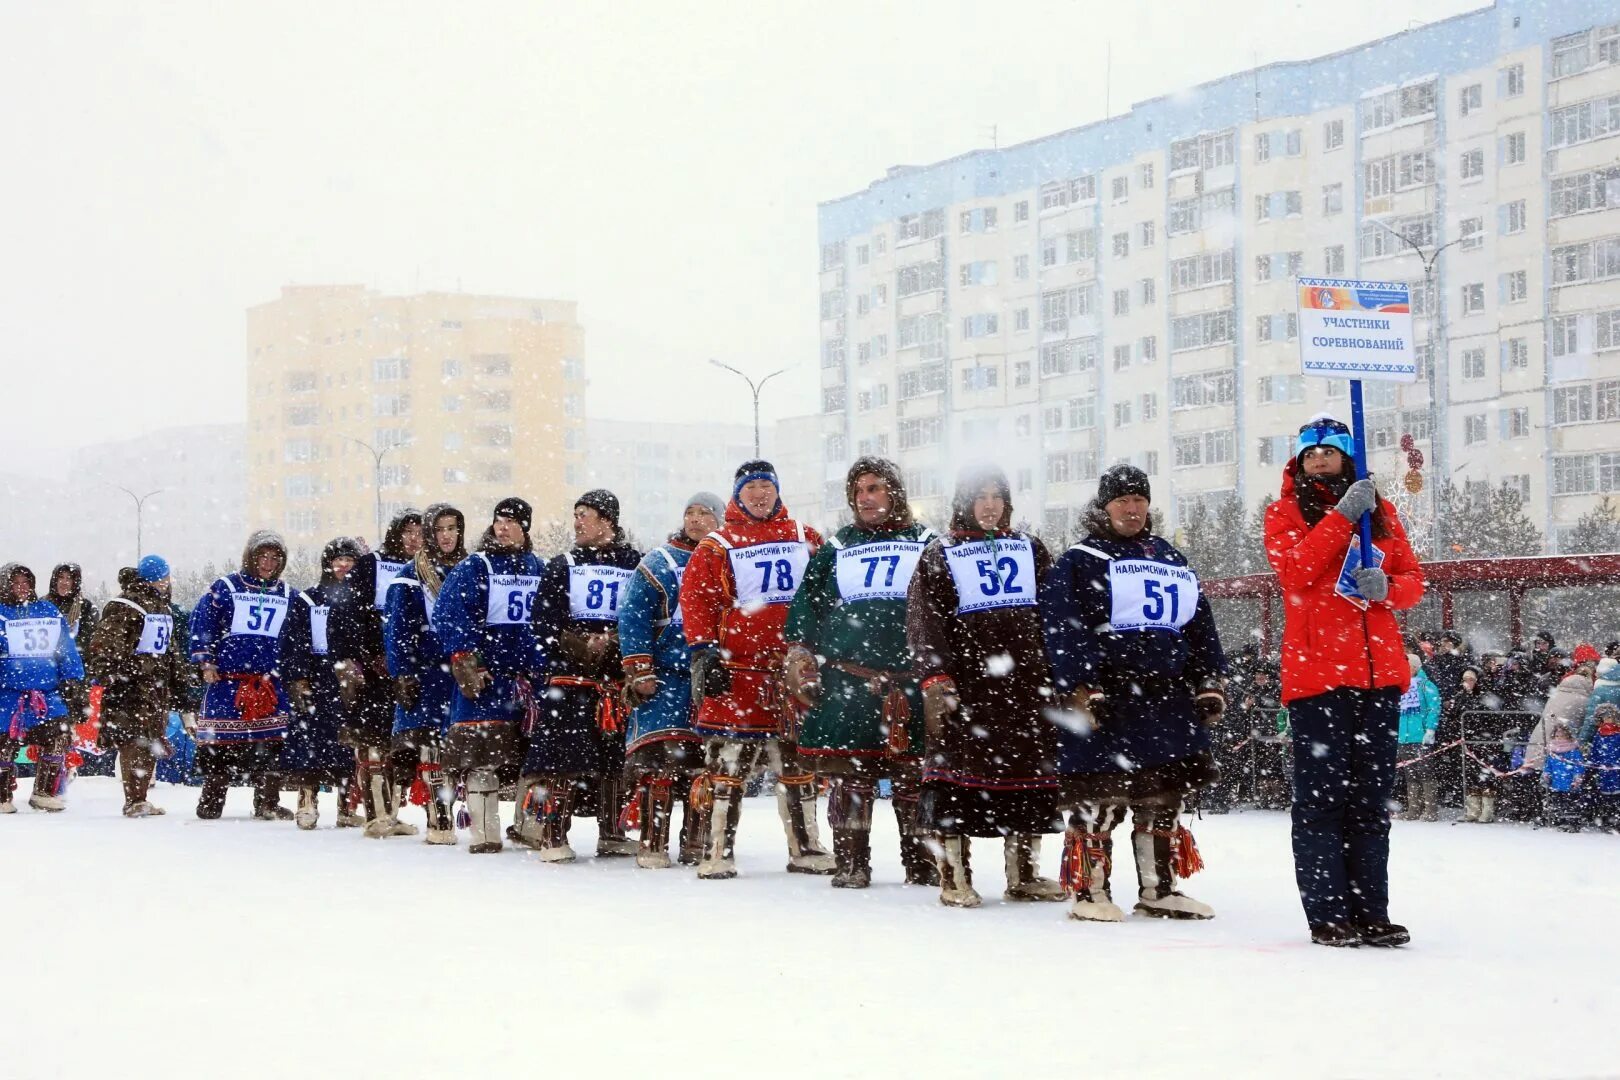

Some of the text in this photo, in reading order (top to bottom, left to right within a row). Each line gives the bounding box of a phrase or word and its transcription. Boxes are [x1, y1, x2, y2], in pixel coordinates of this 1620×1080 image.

[1322, 316, 1391, 330] УЧАСТНИКИ
[1312, 336, 1405, 351] СОРЕВНОВАНИЙ
[734, 546, 781, 560] НАДЫМСКИЙ
[840, 544, 919, 559] НАДЫМСКИЙ РАЙОН
[492, 578, 533, 587] НАДЫМСКИЙ
[754, 558, 794, 593] 78
[860, 555, 901, 588] 77
[976, 556, 1023, 597] 52
[1115, 564, 1169, 577] НАДЫМСКИЙ
[507, 590, 538, 622] 69
[586, 579, 620, 611] 81
[1142, 579, 1179, 624] 51
[247, 605, 277, 632] 57
[23, 627, 50, 651] 53
